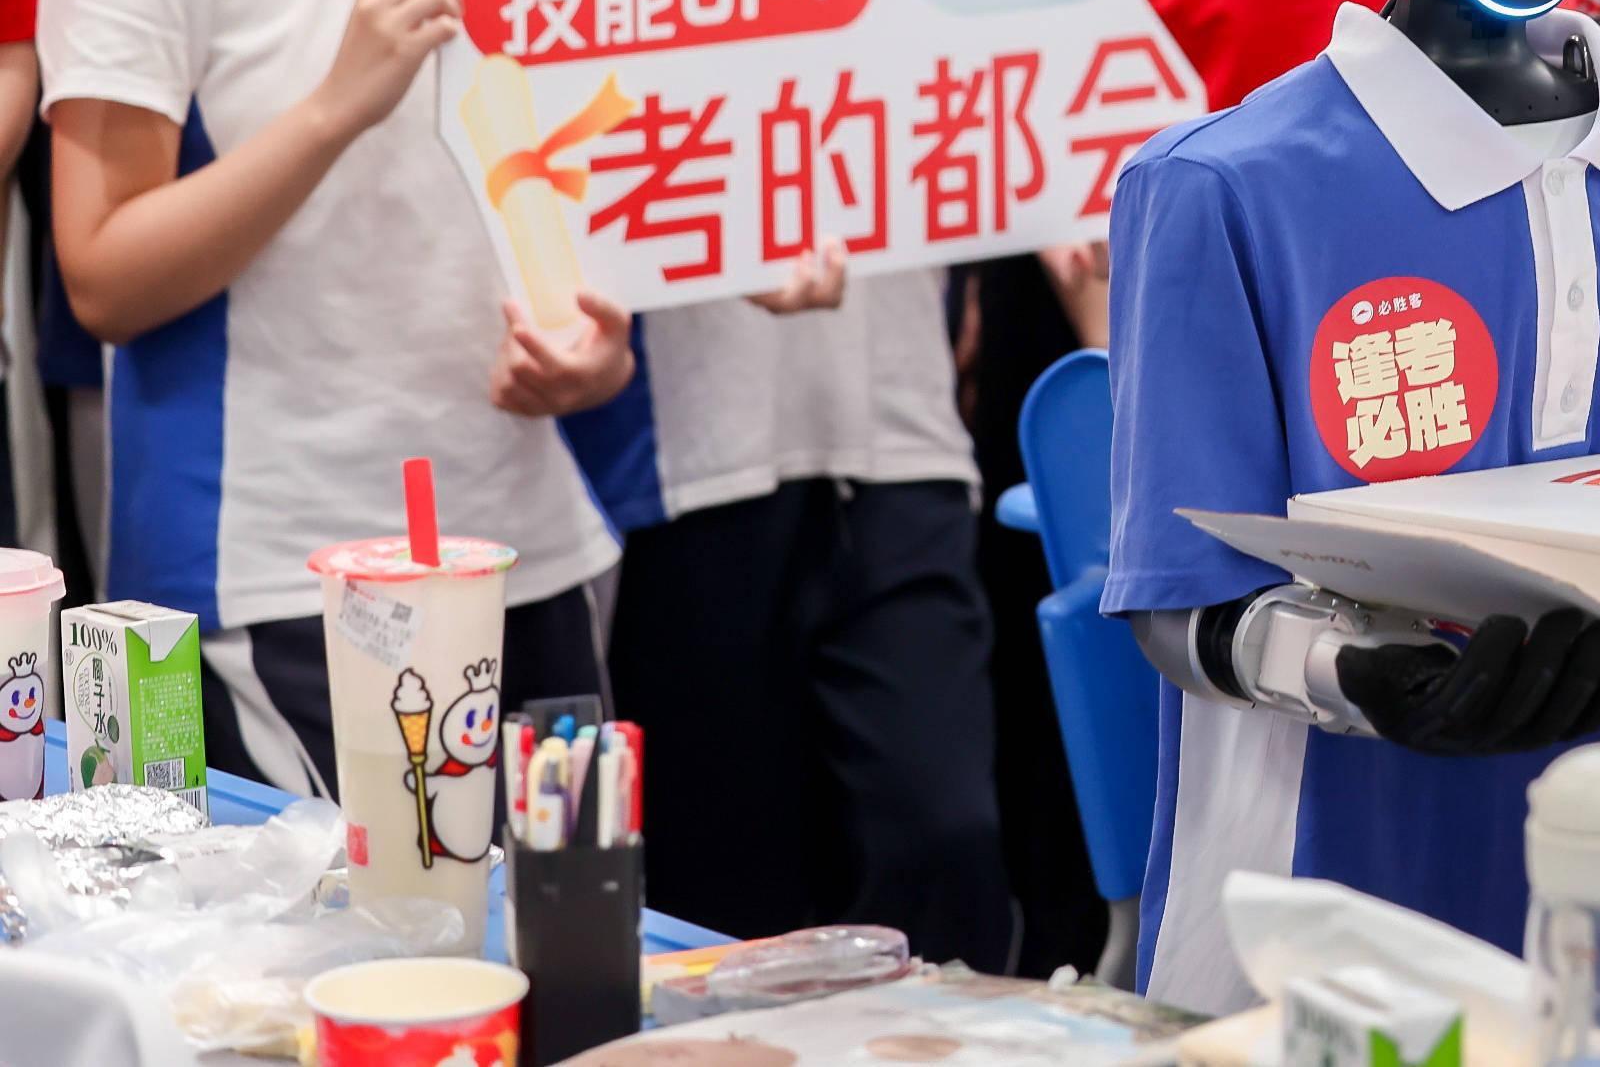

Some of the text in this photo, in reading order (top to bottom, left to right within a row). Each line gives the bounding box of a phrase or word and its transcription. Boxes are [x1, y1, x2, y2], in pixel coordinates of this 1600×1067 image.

[588, 36, 1187, 283] 考的都会
[1377, 292, 1424, 317] 必胜客
[1332, 318, 1457, 405] 逢考
[1347, 379, 1473, 471] 必胜
[68, 621, 118, 657] 100%
